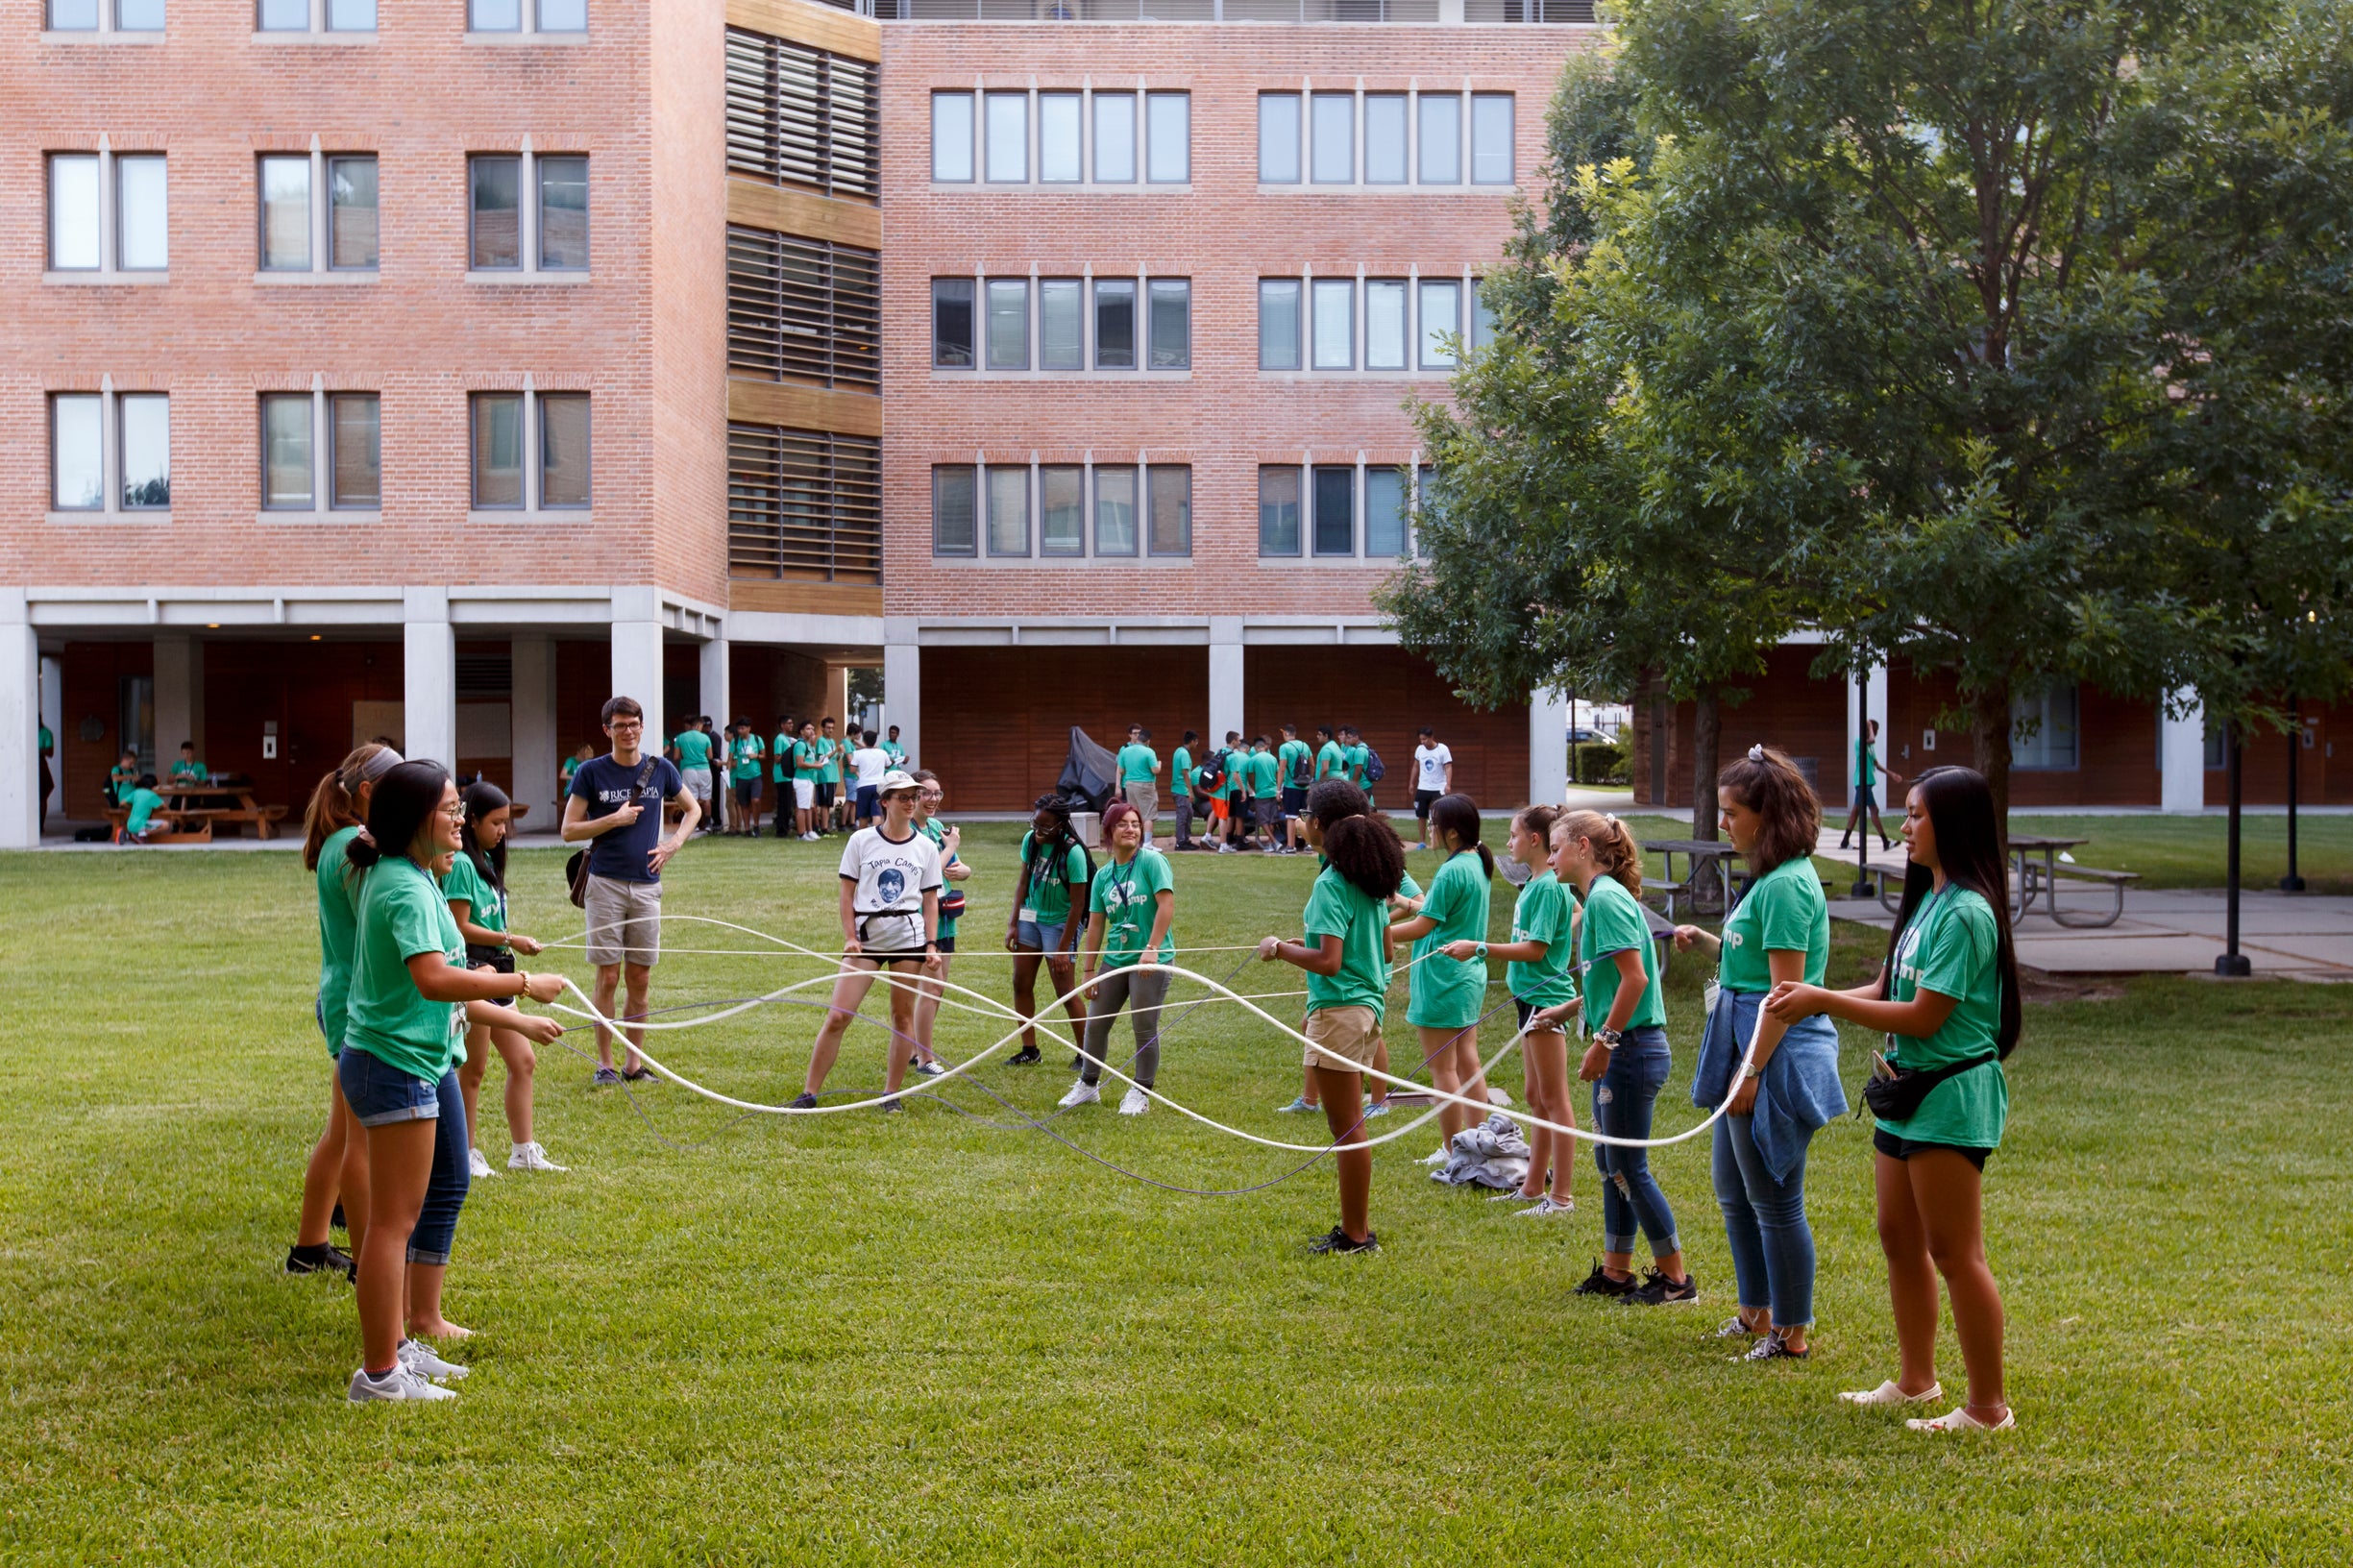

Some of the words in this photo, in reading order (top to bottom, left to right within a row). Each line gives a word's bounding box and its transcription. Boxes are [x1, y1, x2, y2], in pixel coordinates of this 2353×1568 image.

[610, 789, 631, 799] RICE
[639, 786, 659, 798] APIA
[868, 858, 891, 869] Tapia
[895, 857, 919, 875] Camps
